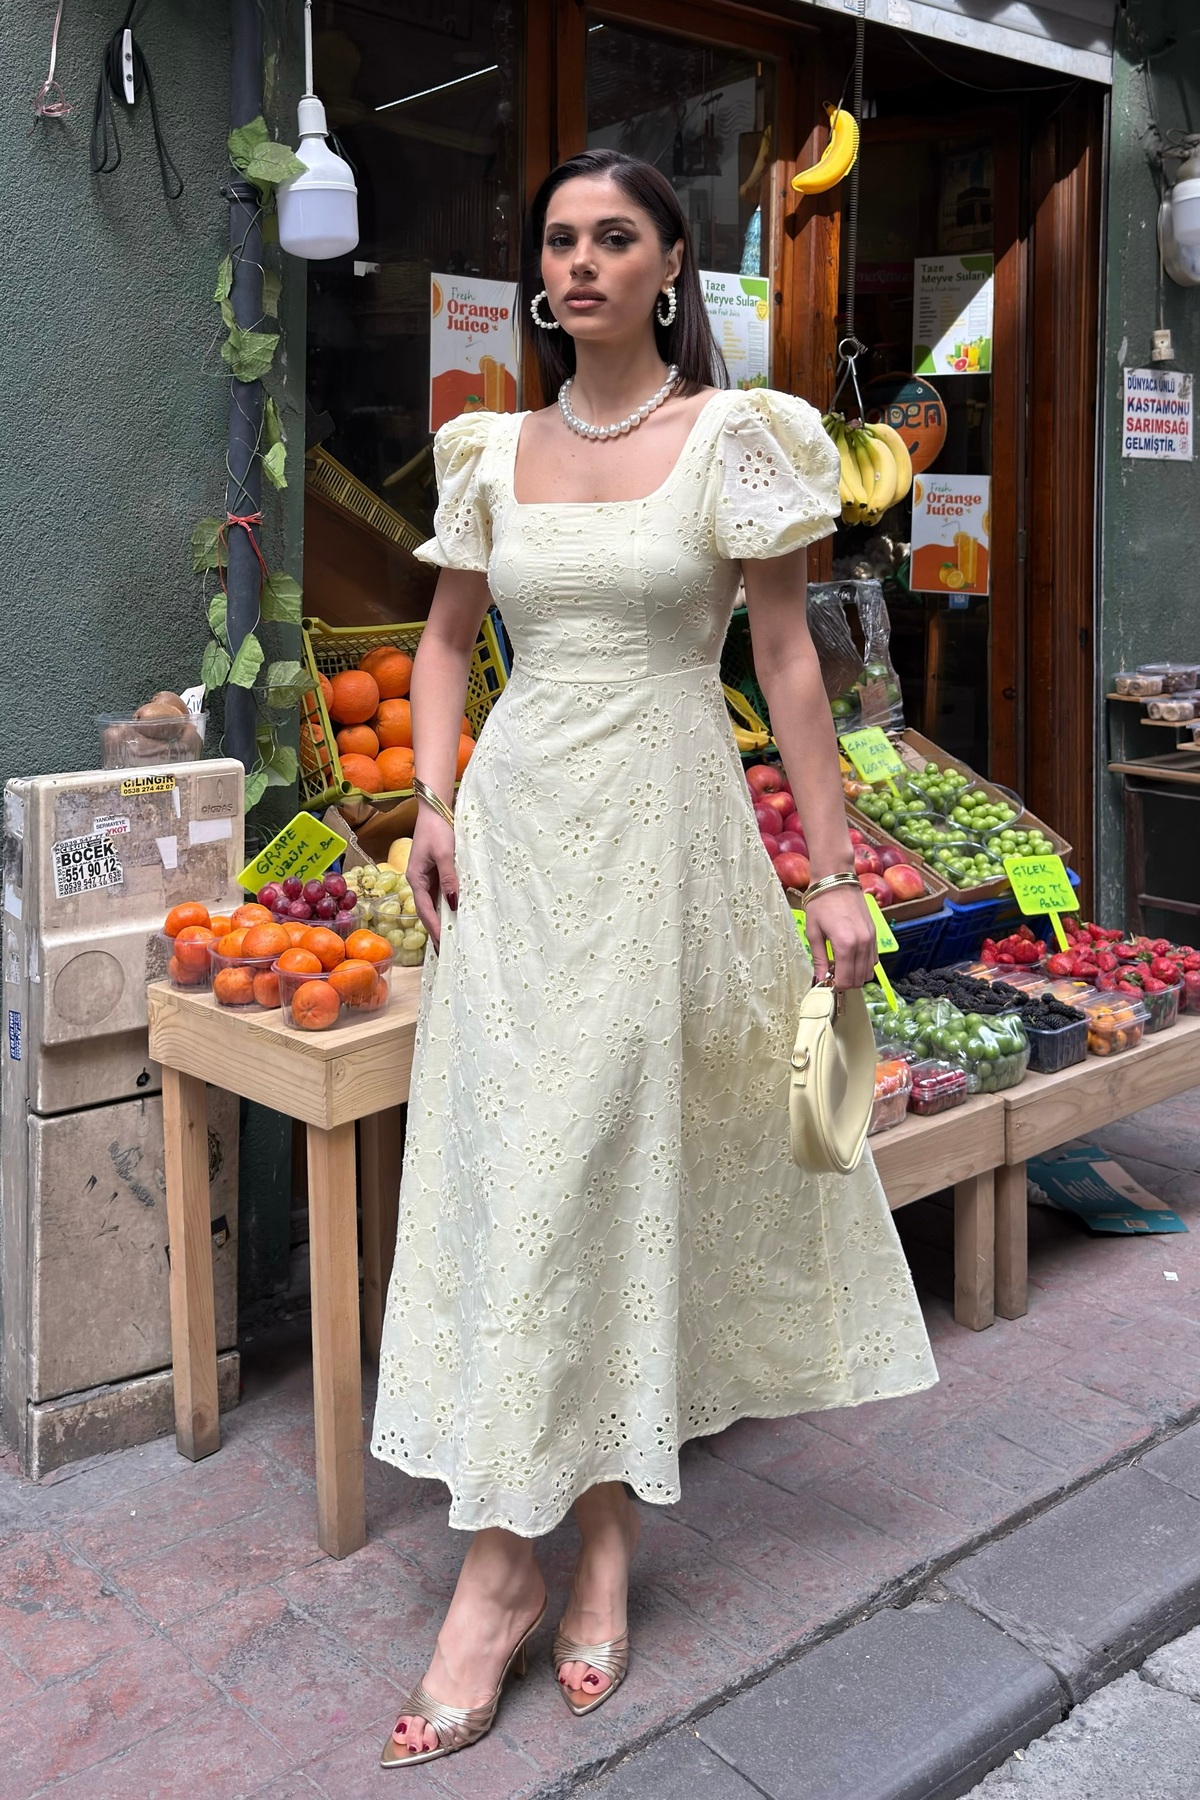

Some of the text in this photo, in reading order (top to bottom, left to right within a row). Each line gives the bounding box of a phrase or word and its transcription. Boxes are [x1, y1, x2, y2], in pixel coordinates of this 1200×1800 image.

[922, 264, 944, 273] Taze
[705, 280, 726, 291] Taze
[922, 274, 953, 286] Meyve
[451, 287, 476, 301] Fresh
[704, 293, 757, 307] Meyve Sular
[447, 300, 509, 322] Orange
[447, 315, 489, 333] Juice
[1127, 375, 1157, 392] DÜNYACA
[1127, 396, 1190, 416] KASTAMONU
[1126, 417, 1189, 435] SARIMSAĞI
[1125, 435, 1176, 454] GELMİŞTİR.
[931, 482, 952, 493] Fresh
[926, 492, 982, 507] Orange
[926, 504, 963, 516] Juice
[847, 739, 867, 751] CAN
[256, 828, 297, 874] GRAPE
[274, 840, 309, 877] ÜZÜM
[66, 865, 84, 882] 551
[87, 862, 101, 877] 90
[104, 858, 116, 873] 12
[64, 880, 82, 891] 0539
[83, 877, 96, 886] 547
[99, 874, 107, 882] 77
